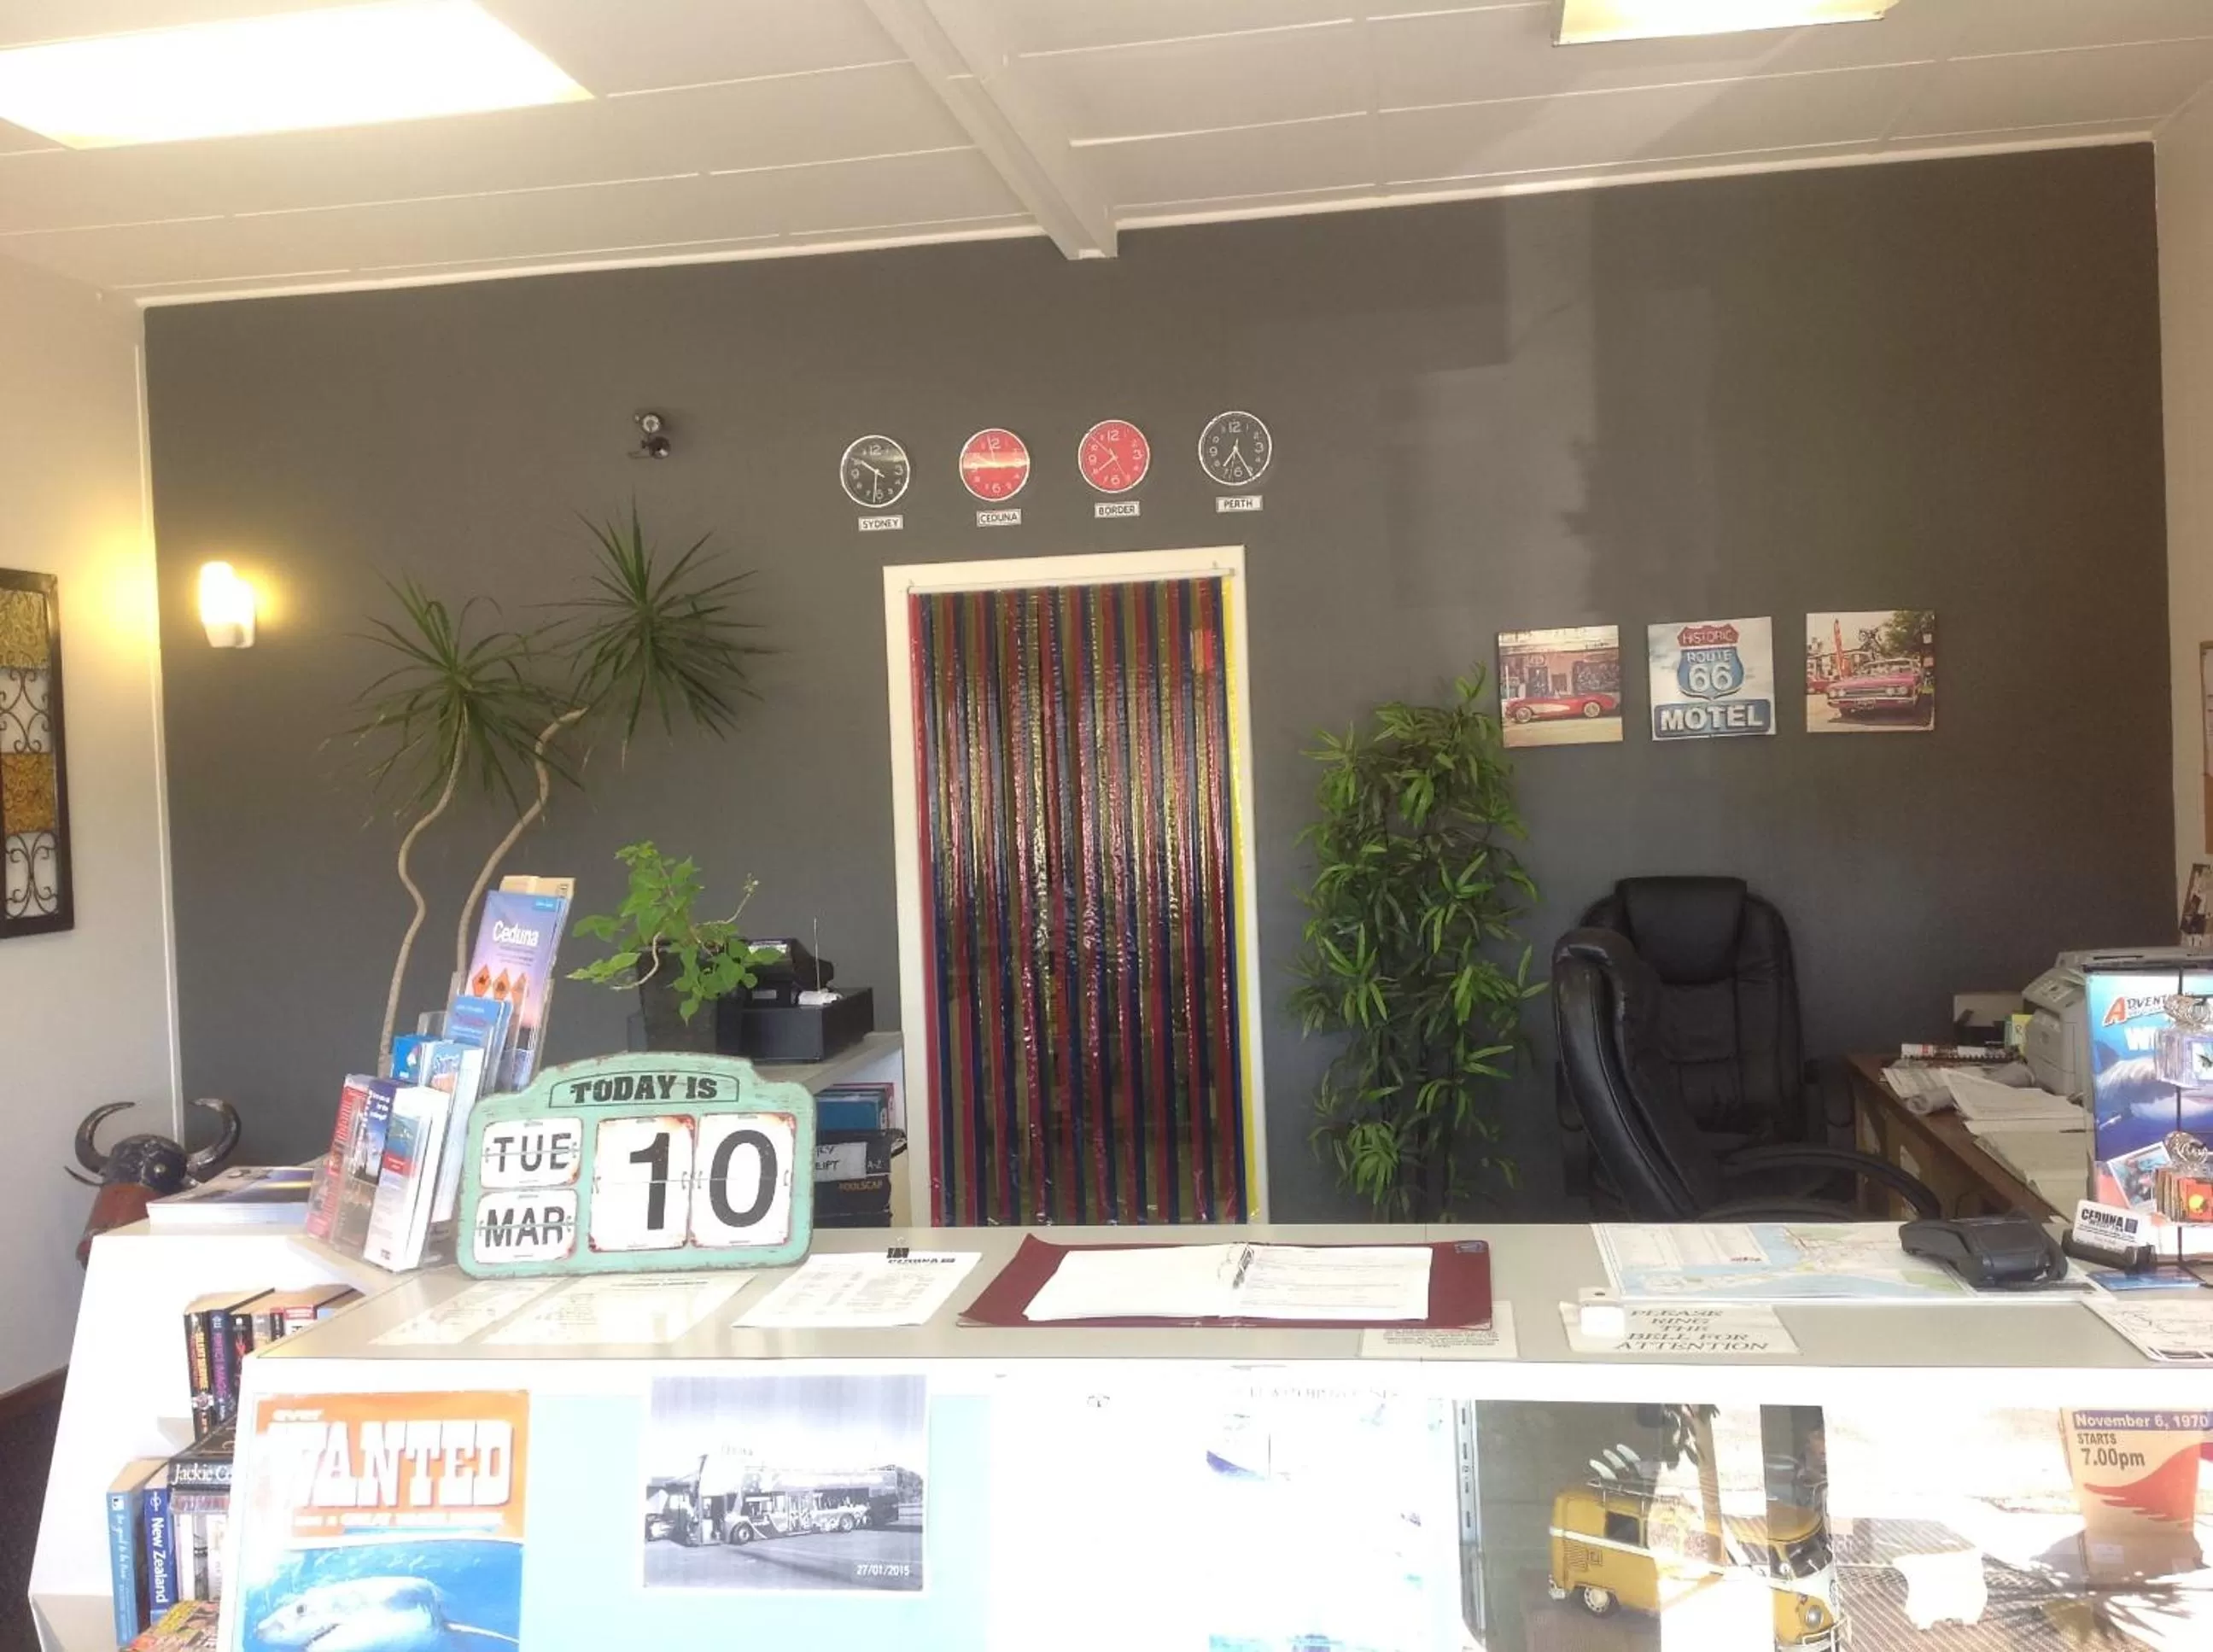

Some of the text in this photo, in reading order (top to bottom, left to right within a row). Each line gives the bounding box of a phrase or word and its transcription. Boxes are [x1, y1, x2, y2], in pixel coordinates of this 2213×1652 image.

[1098, 505, 1136, 516] BORDER
[1223, 499, 1252, 509] PERTH
[862, 518, 899, 528] SYDNEY
[980, 512, 1018, 522] CEDUNA
[1681, 629, 1734, 645] HISTORIC
[1687, 649, 1732, 664] ROUTE
[1688, 663, 1733, 692] 66
[1659, 704, 1765, 732] MOTEL
[493, 919, 540, 947] Ceduna
[569, 1074, 717, 1105] TODAY IS
[493, 1131, 573, 1173] TUE
[629, 1129, 779, 1231] 10
[483, 1205, 565, 1248] MAR
[1613, 1341, 1770, 1351] ATTENTION
[2075, 1413, 2210, 1429] November 6, 1970
[2076, 1433, 2117, 1445] STARTS
[2080, 1447, 2146, 1471] 7.00pm
[171, 1462, 213, 1486] Jackie
[150, 1516, 170, 1603] New Zealand
[856, 1563, 910, 1577] 27/01/2015
